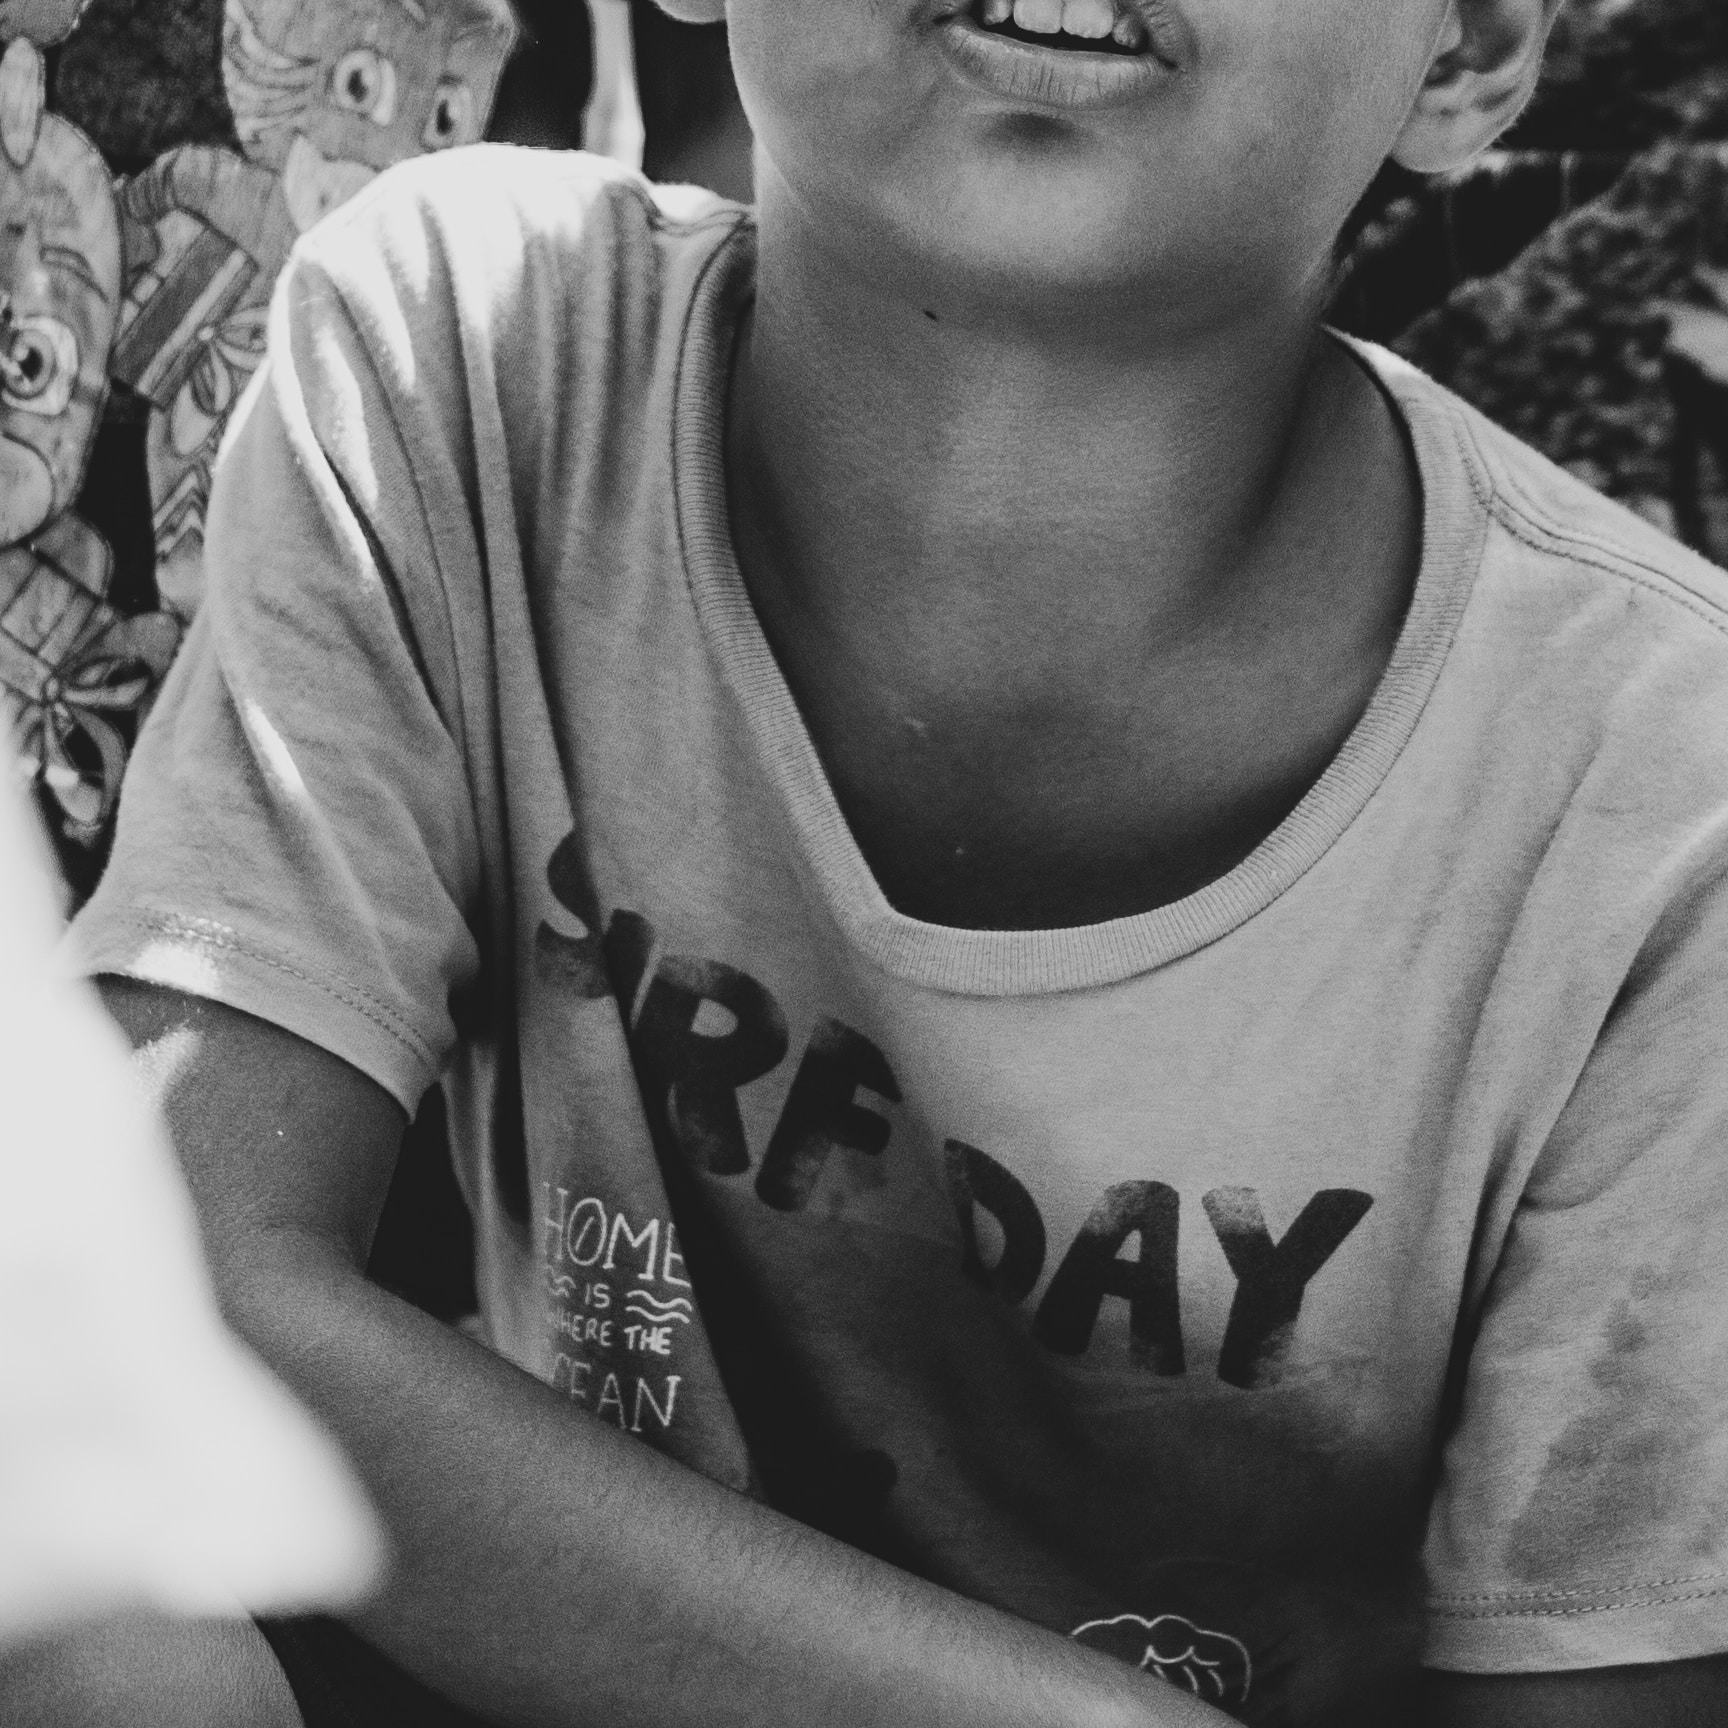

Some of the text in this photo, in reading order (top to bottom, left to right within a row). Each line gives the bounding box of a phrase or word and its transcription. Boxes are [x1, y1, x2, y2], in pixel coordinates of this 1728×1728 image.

[541, 1181, 692, 1288] HOME
[943, 1139, 1374, 1390] DAY
[550, 1310, 673, 1356] HERE THE
[583, 1282, 611, 1309] IS
